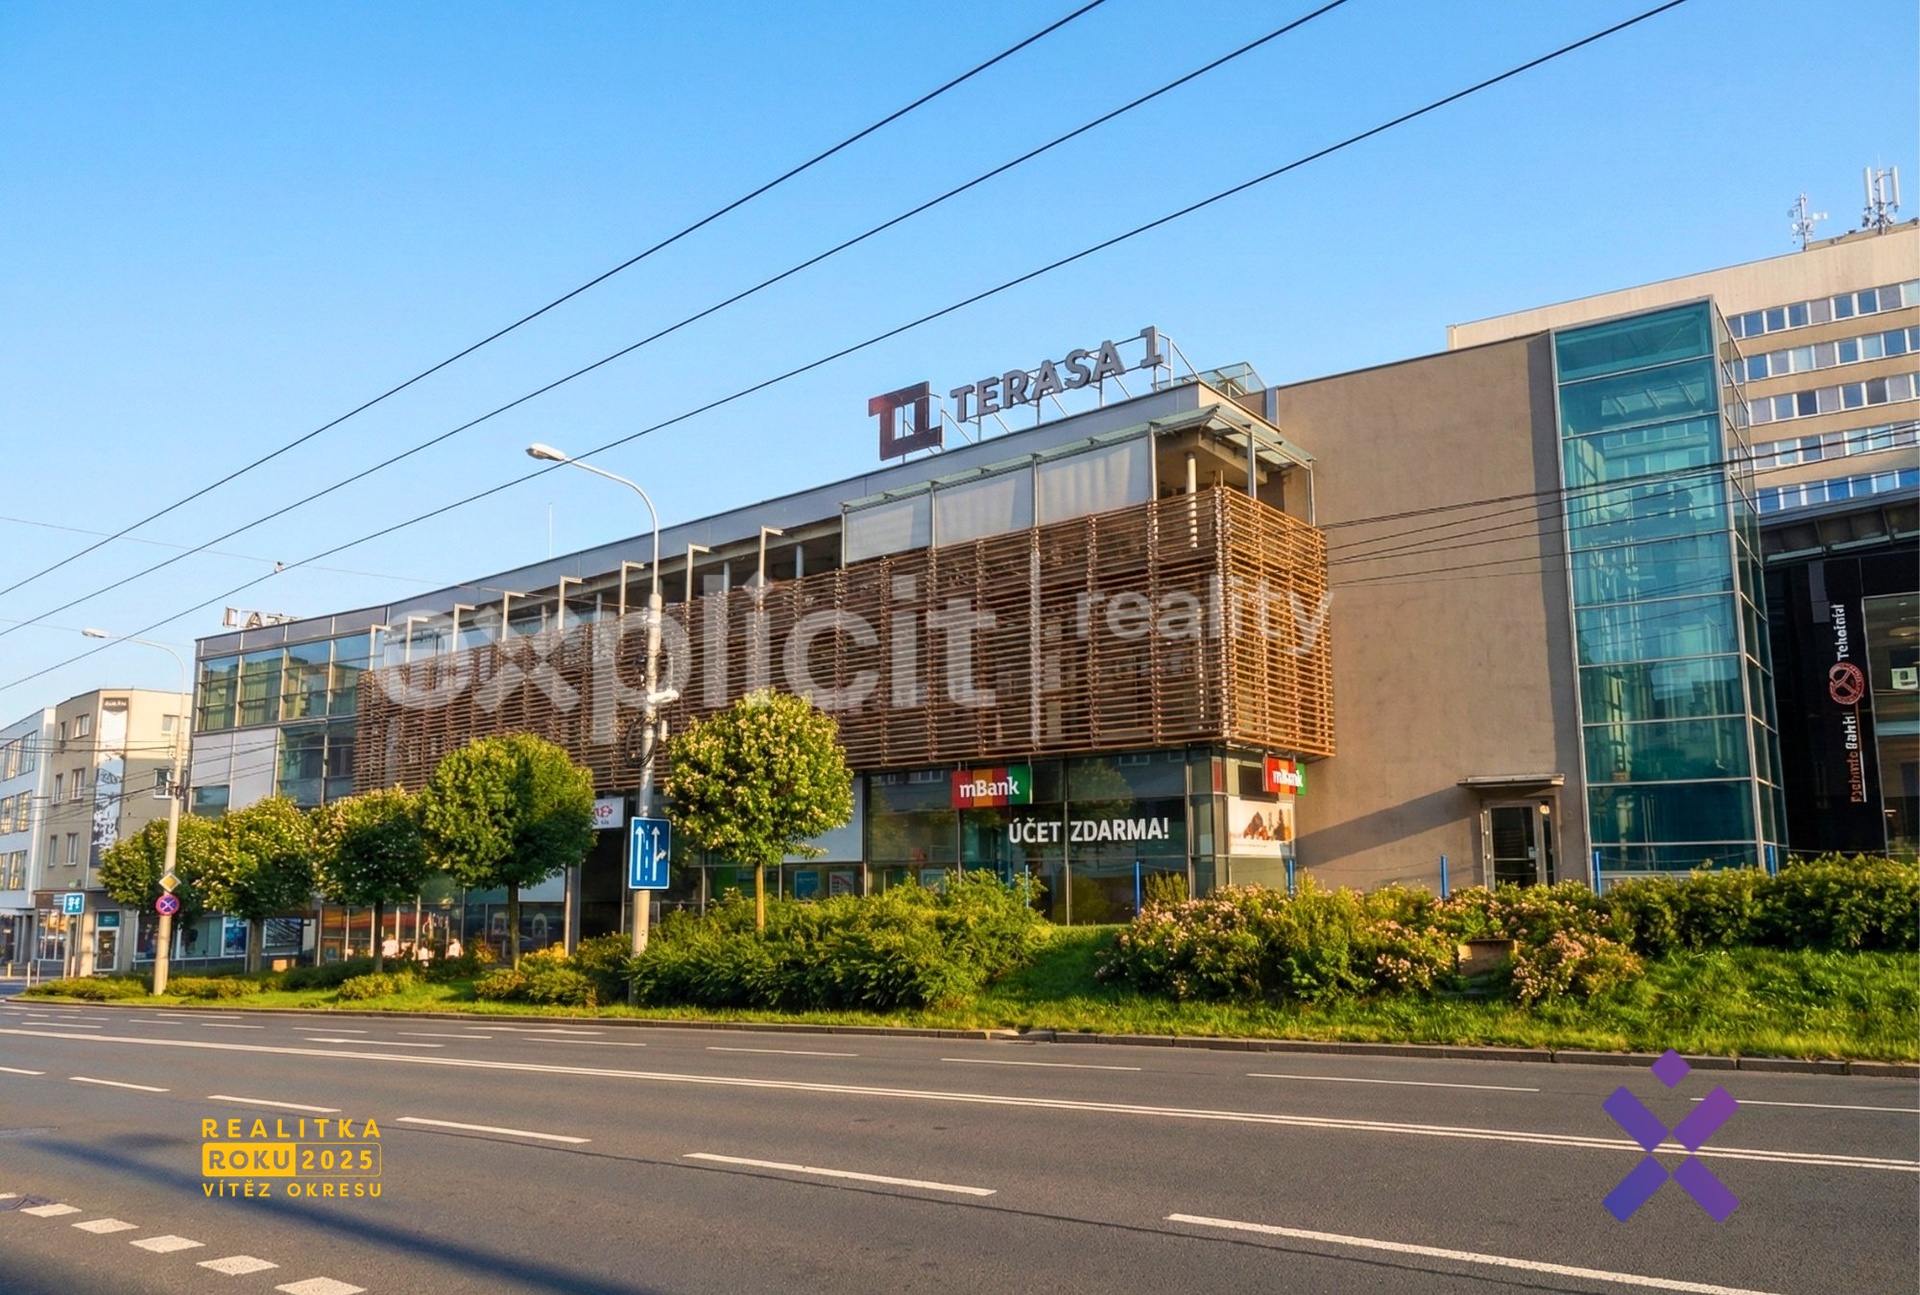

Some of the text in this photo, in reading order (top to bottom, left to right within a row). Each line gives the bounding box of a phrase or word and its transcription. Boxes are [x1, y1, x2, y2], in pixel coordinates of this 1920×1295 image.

[950, 325, 1164, 423] TERASA 1
[959, 776, 1019, 799] mBank
[1009, 817, 1170, 843] ÚČET ZDARMA!
